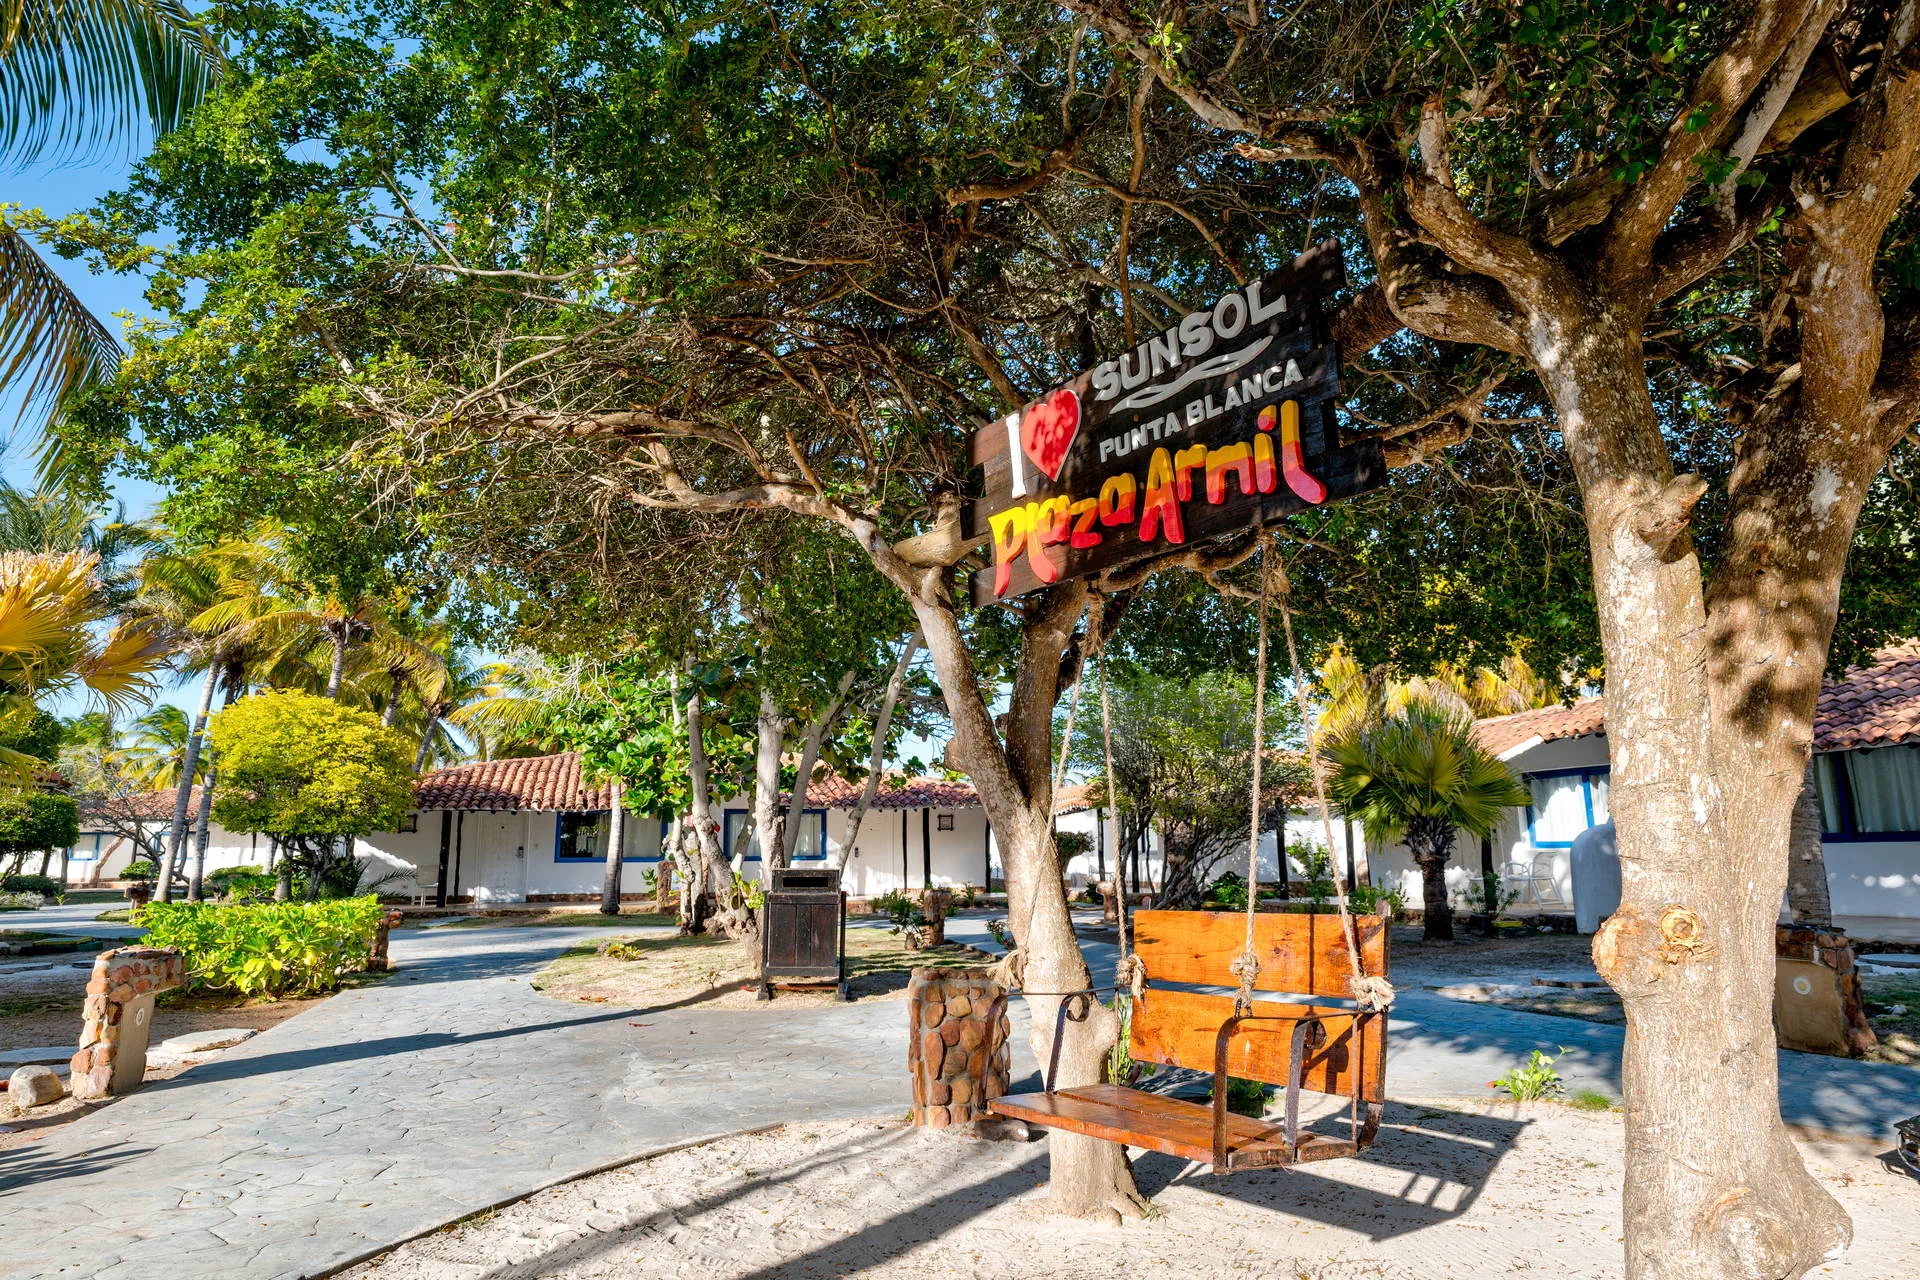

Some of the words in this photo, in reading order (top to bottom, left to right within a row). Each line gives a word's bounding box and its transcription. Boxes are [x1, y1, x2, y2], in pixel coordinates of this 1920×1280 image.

[1091, 280, 1287, 401] SUNSOL
[1005, 412, 1028, 499] I
[1100, 412, 1182, 463] PUNTA
[1185, 358, 1304, 427] BLANCA
[1138, 399, 1327, 544] Armil
